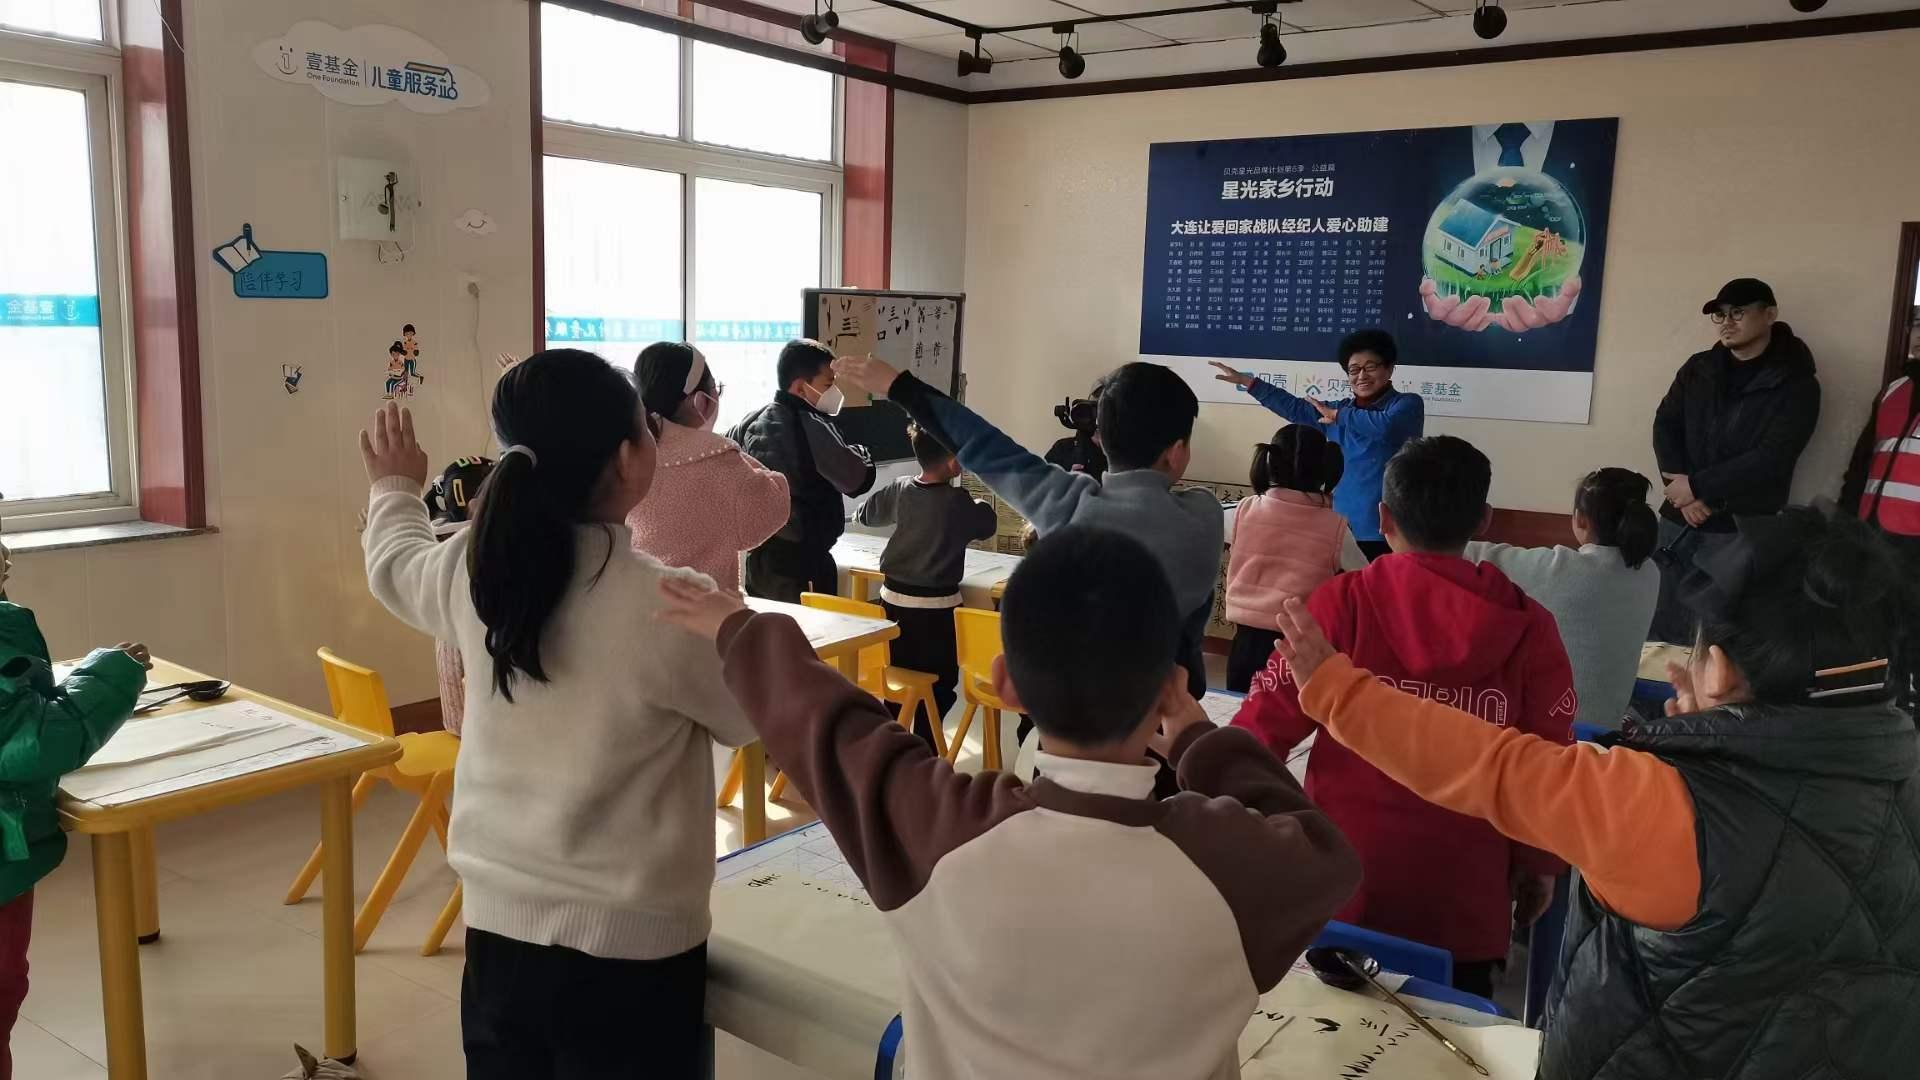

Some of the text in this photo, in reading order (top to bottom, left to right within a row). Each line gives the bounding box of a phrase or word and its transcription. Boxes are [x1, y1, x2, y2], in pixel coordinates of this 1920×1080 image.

[306, 52, 358, 77] 壹基金
[306, 72, 360, 87] One Foundation
[1221, 177, 1335, 200] 星光家乡行动
[1171, 215, 1390, 235] 大连让爱回家战队经纪人爱心助建
[239, 271, 302, 291] 陪伴学习
[1421, 382, 1463, 396] 壹基金
